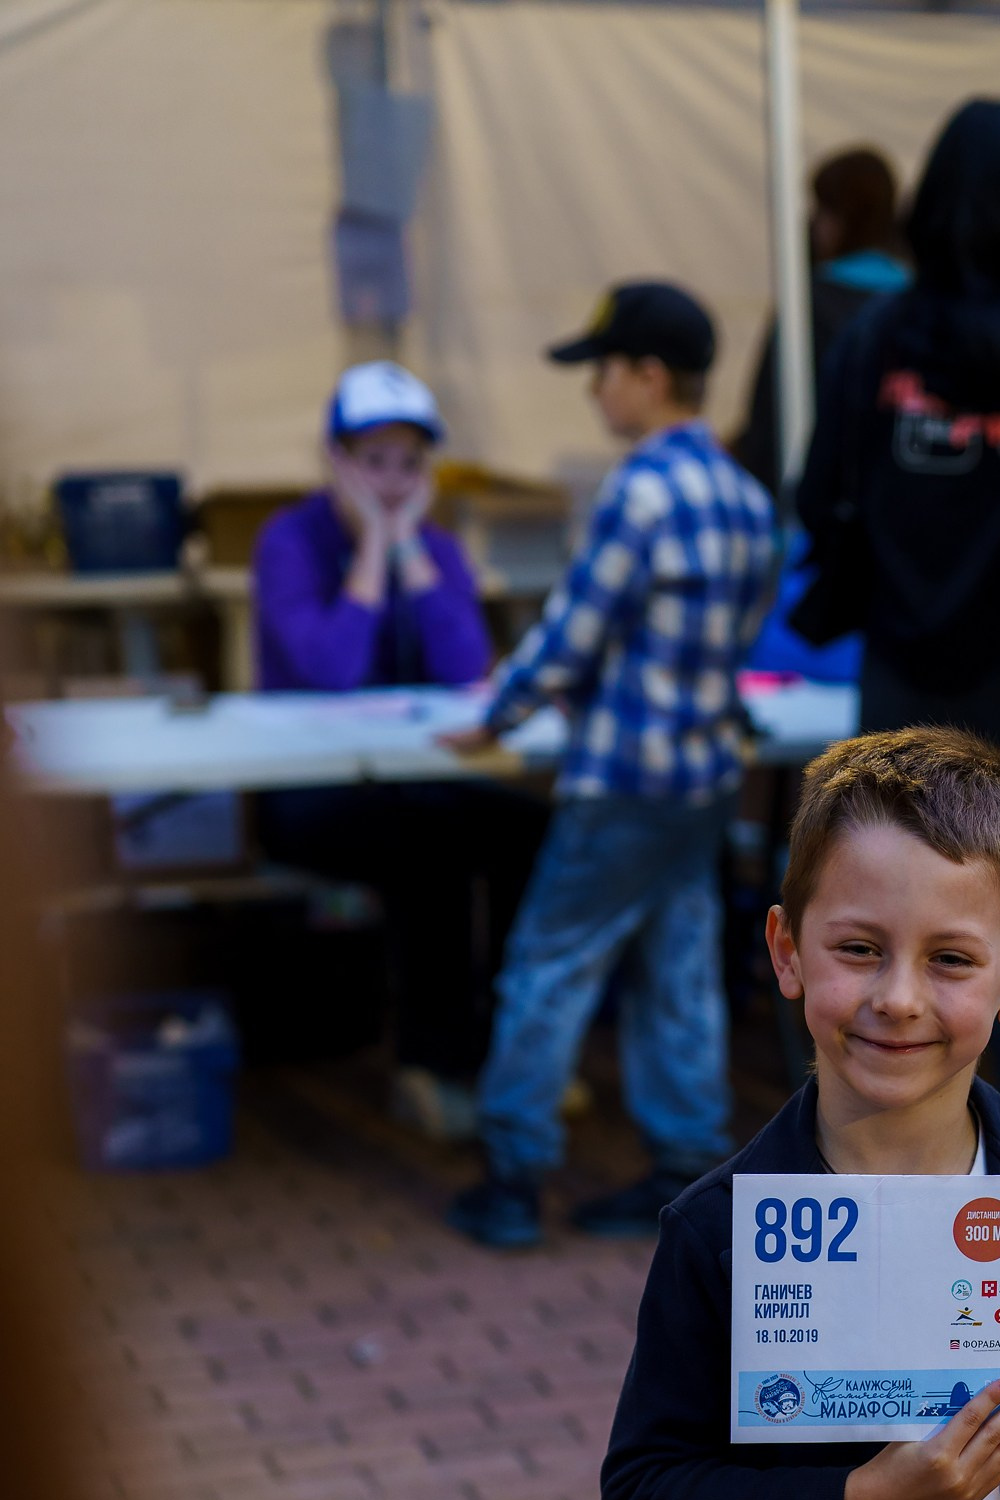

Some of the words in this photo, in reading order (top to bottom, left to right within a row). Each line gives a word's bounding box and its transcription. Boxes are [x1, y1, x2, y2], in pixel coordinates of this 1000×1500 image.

[755, 1197, 859, 1263] 892
[965, 1225, 990, 1242] 300
[754, 1284, 813, 1301] ГАНИЧЕВ
[754, 1303, 810, 1319] КИРИЛЛ
[755, 1329, 819, 1343] 18.10.2019
[845, 1377, 912, 1391] КАЛУЖСКИЙ
[820, 1400, 912, 1419] МАРАФОН
